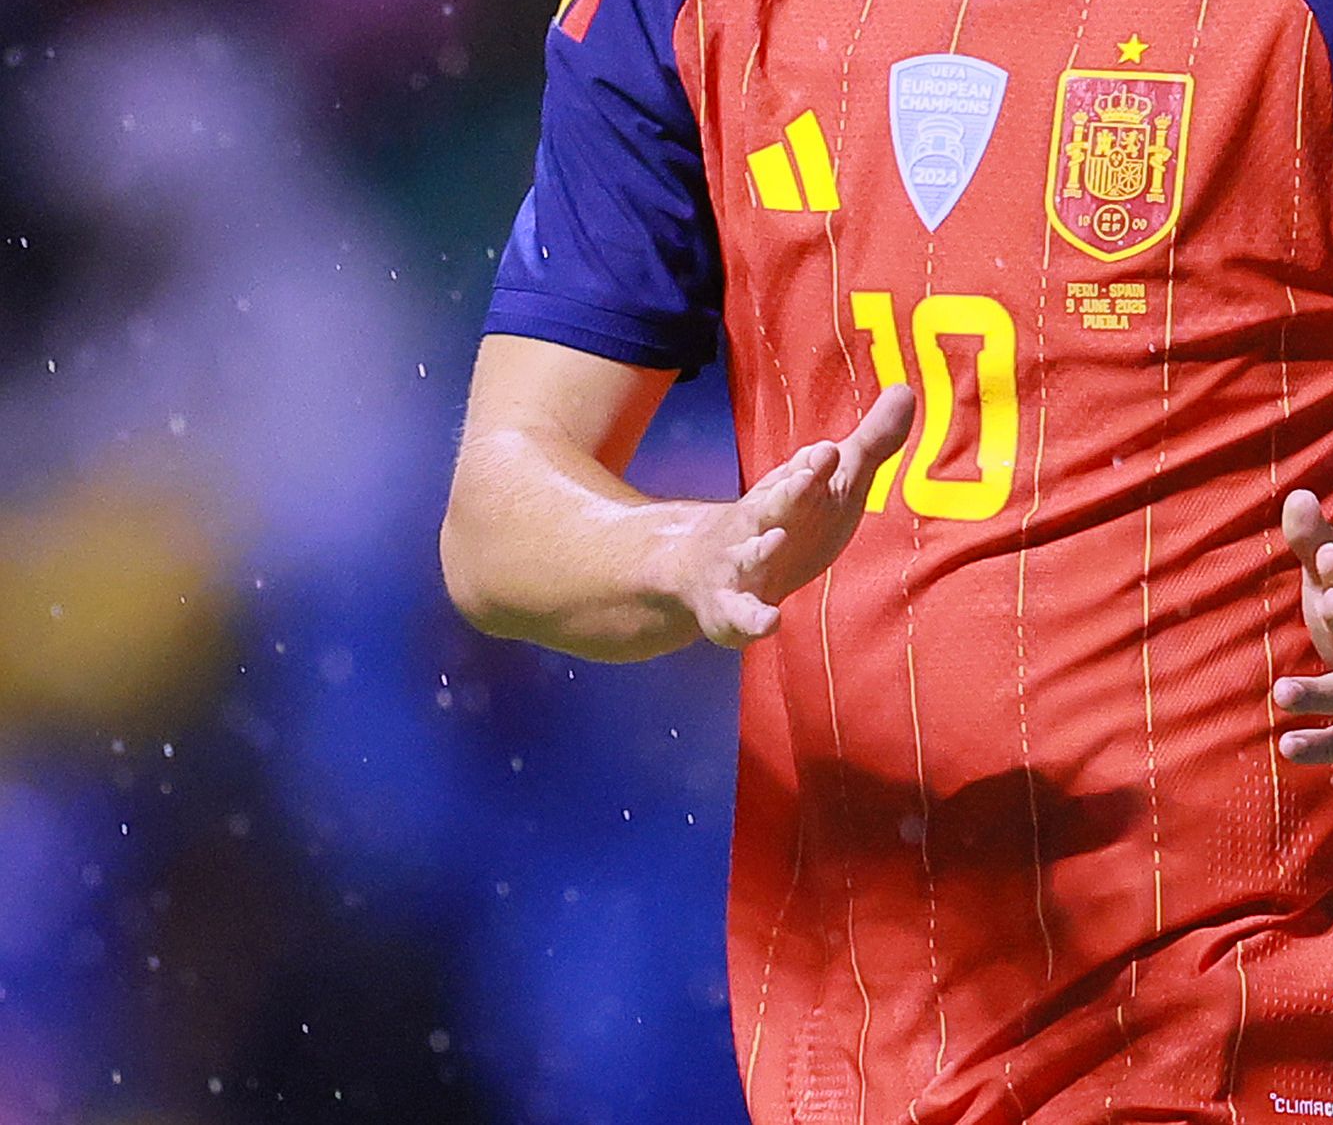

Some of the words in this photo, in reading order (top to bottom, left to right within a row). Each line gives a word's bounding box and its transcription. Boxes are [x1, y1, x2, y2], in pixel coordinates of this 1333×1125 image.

[931, 65, 966, 79] UEFA
[901, 78, 992, 99] EUROPEAN
[900, 95, 990, 114] CHAMPIONS
[913, 167, 957, 186] 2024
[1067, 283, 1099, 297] PERU
[1108, 283, 1145, 298] SPAIN
[1065, 298, 1075, 313] 9
[1079, 299, 1111, 313] JUNE
[1082, 314, 1129, 330] PUEBLA
[850, 291, 1019, 521] 10
